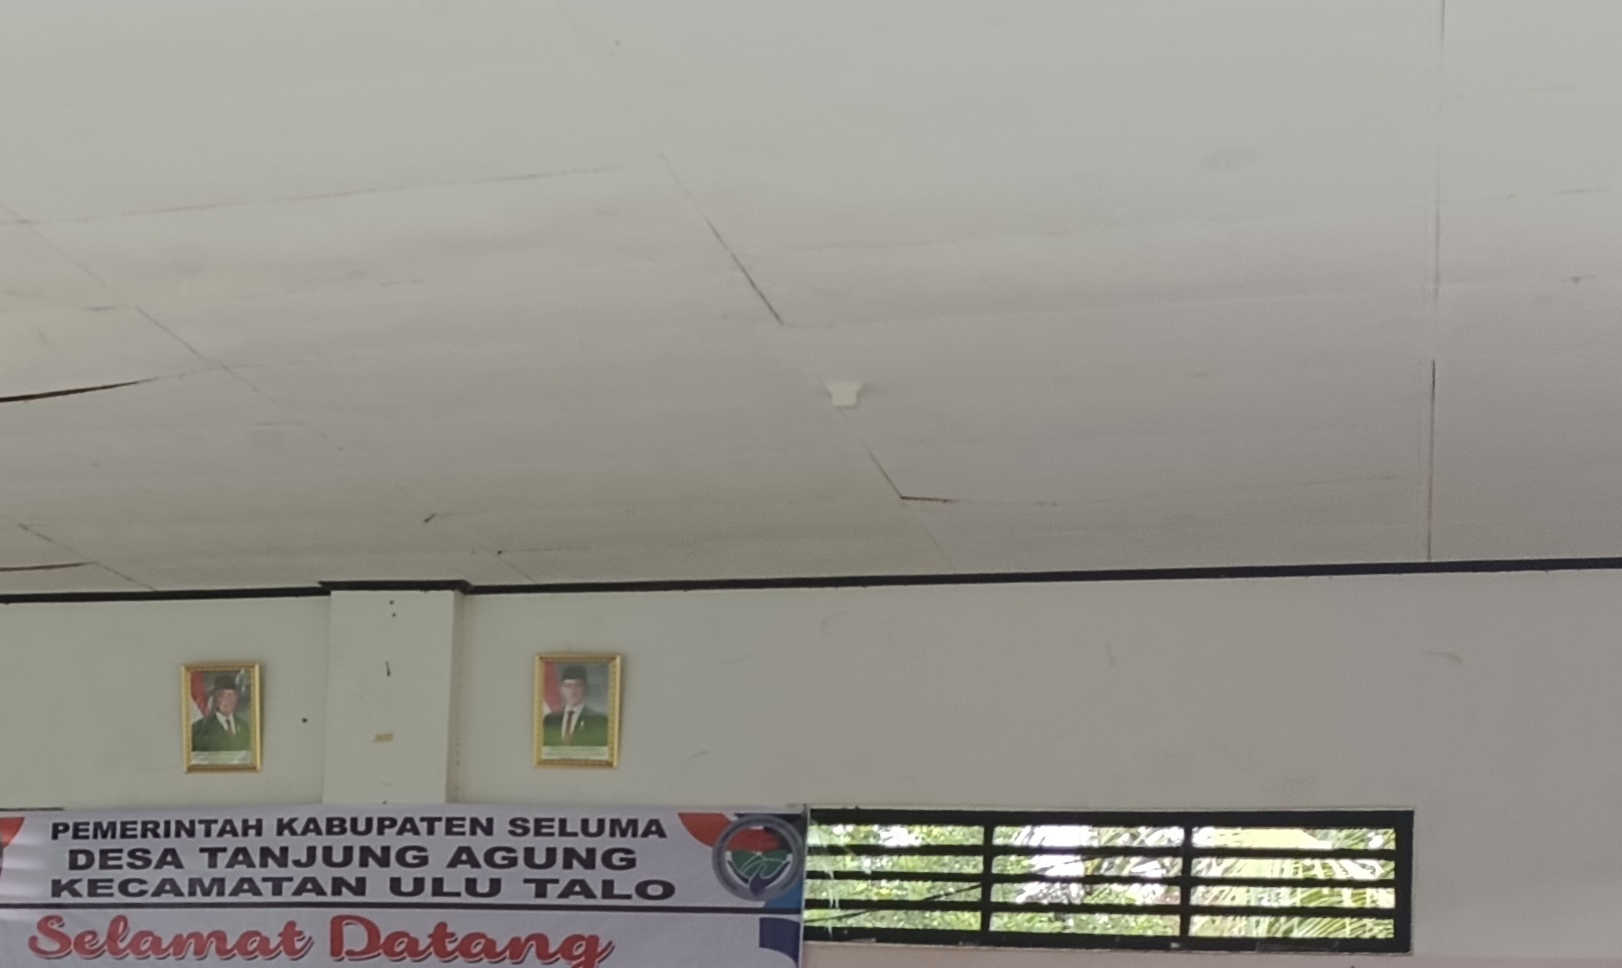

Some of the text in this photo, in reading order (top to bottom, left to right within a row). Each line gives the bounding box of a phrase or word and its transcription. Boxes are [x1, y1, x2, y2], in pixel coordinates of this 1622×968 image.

[50, 815, 668, 841] PEMERINTAH KABUPATEN SELUMA
[67, 844, 638, 871] DESA TANJUNG AGUNG
[50, 875, 677, 901] KECAMATAN ULU TALO
[27, 914, 315, 960] Selamat
